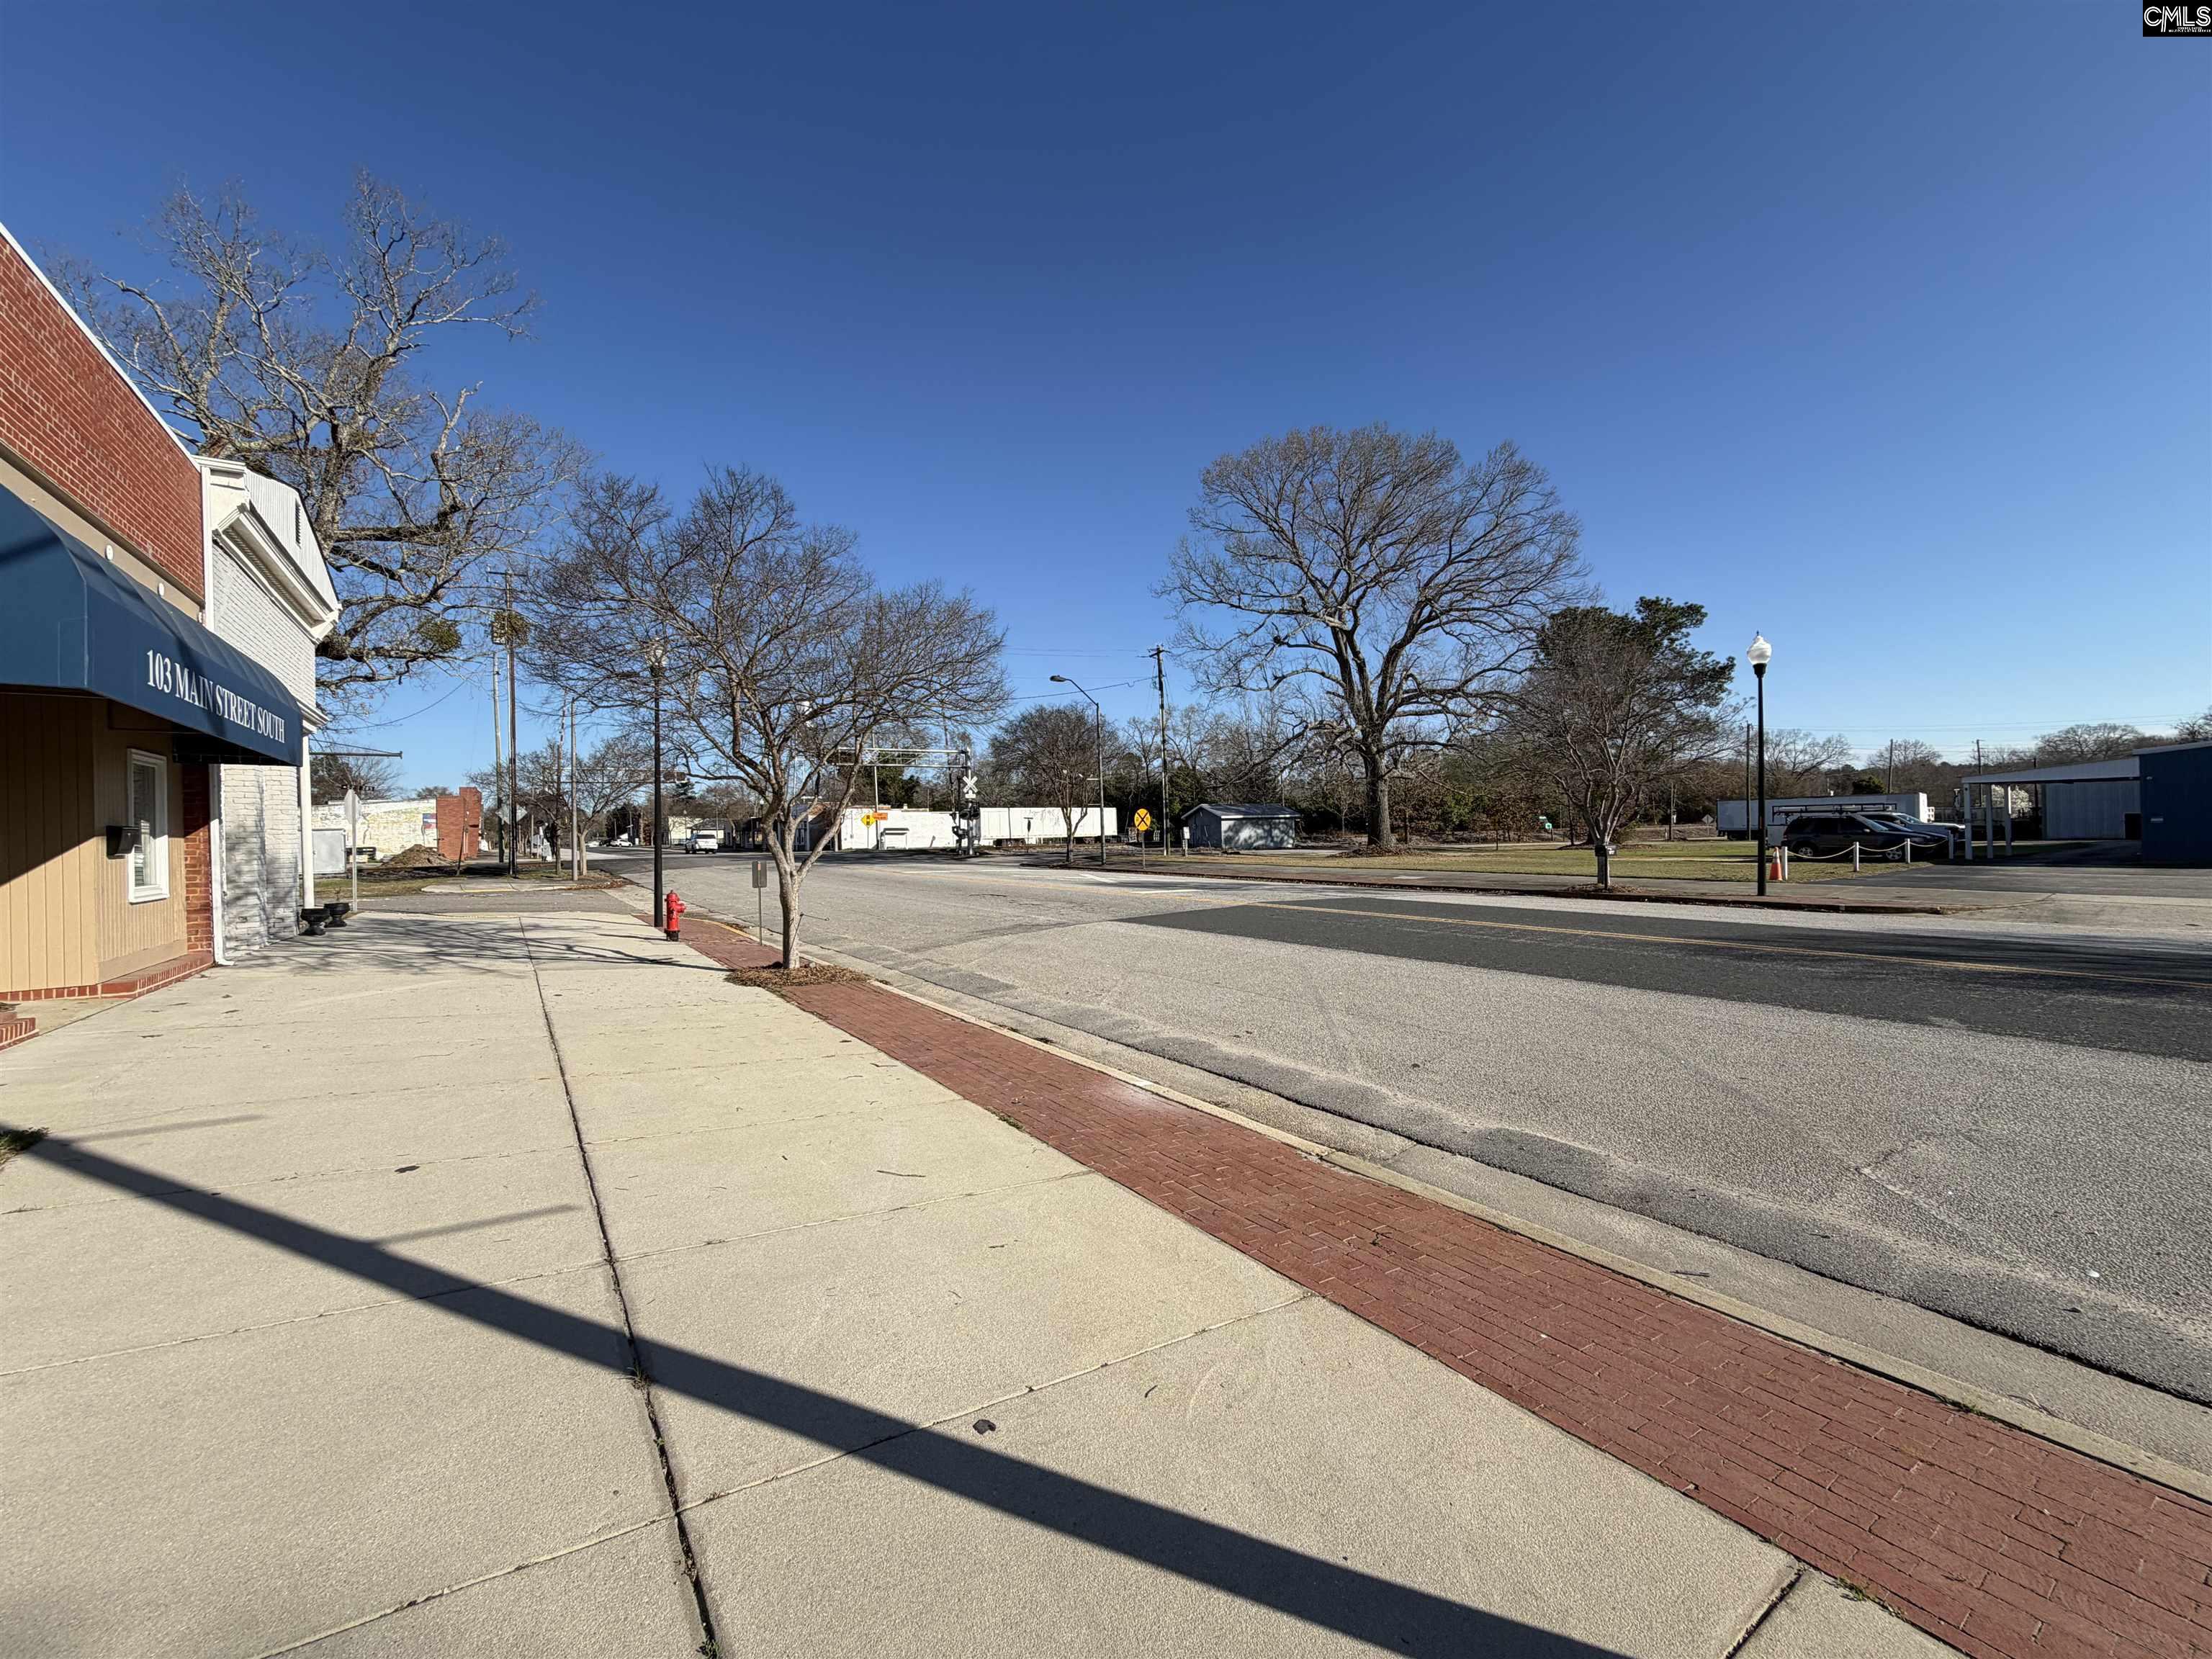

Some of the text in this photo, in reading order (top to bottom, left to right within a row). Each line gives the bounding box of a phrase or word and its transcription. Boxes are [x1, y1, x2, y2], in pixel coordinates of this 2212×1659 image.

[146, 649, 285, 744] 103 MAIN STREET SOUTH
